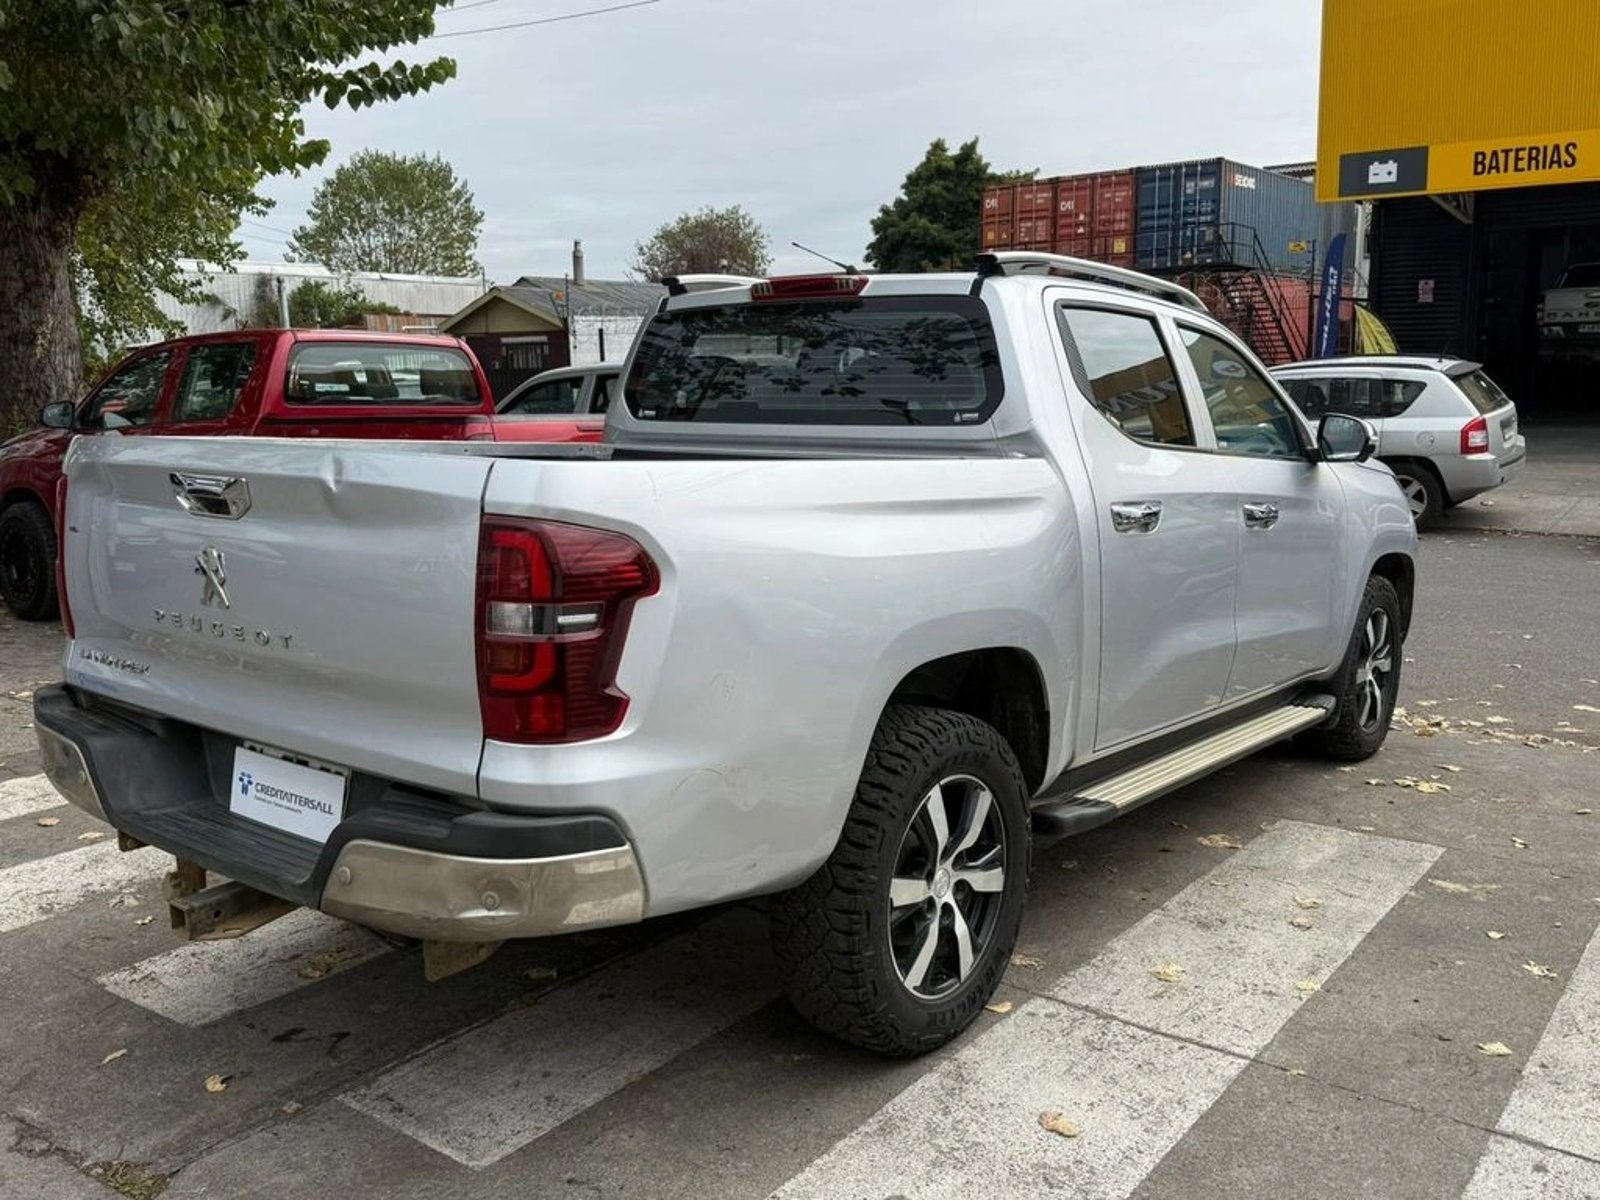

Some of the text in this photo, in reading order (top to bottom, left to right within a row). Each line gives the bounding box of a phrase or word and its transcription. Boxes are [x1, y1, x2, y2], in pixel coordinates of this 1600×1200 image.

[1473, 142, 1577, 176] BATERIAS
[153, 608, 293, 648] PEUGEOT
[254, 782, 334, 815] CREDITATTERSALL
